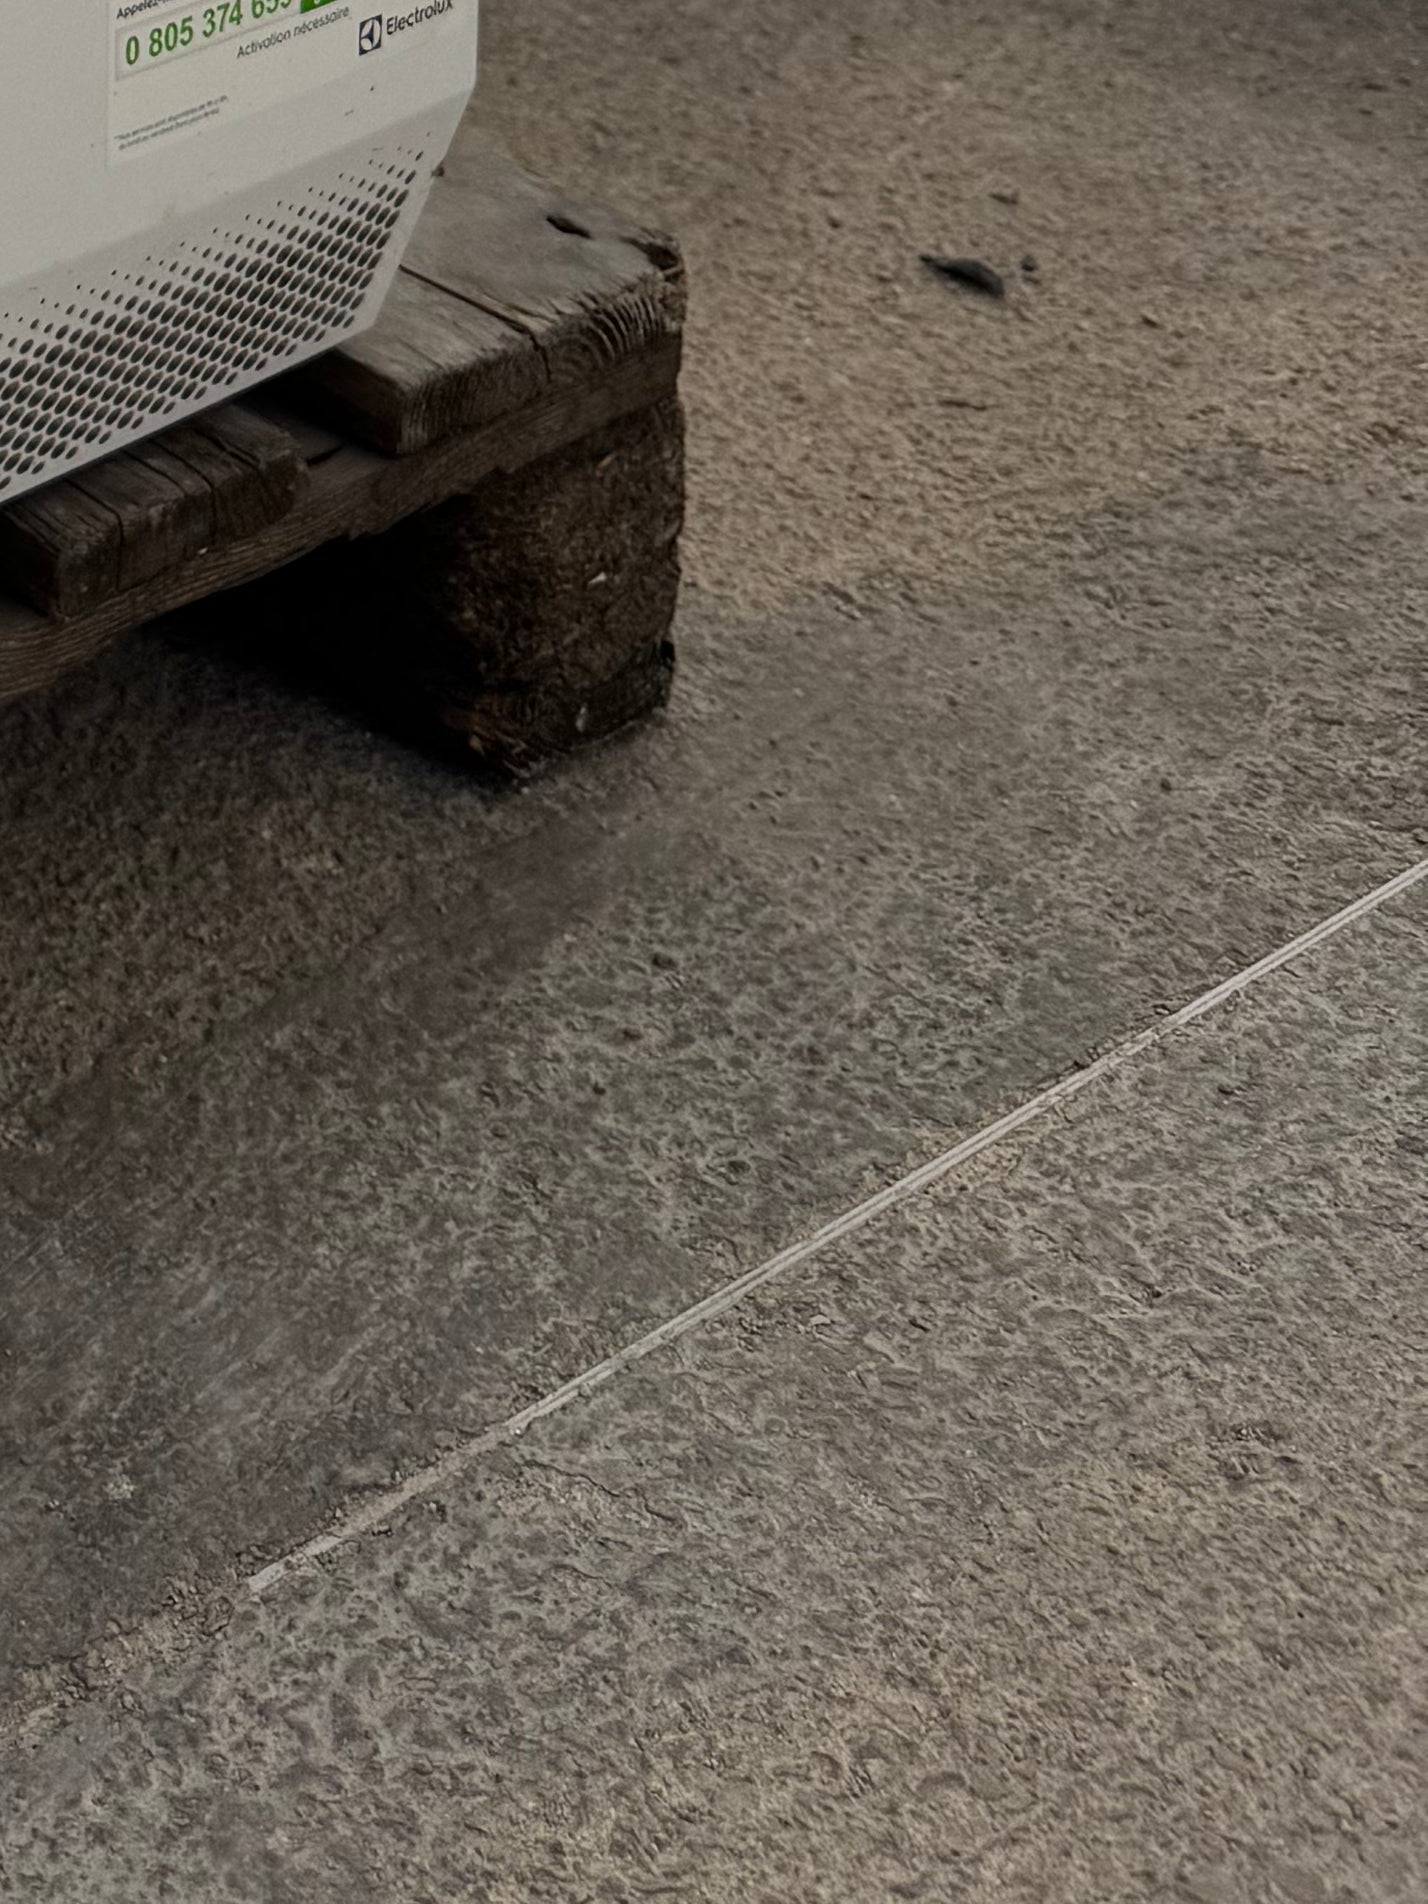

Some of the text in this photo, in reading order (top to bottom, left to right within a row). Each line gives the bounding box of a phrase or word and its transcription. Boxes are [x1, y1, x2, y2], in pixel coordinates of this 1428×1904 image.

[125, 35, 140, 66] 0
[148, 15, 194, 58] 805
[236, 6, 350, 60] Activation nécessaire
